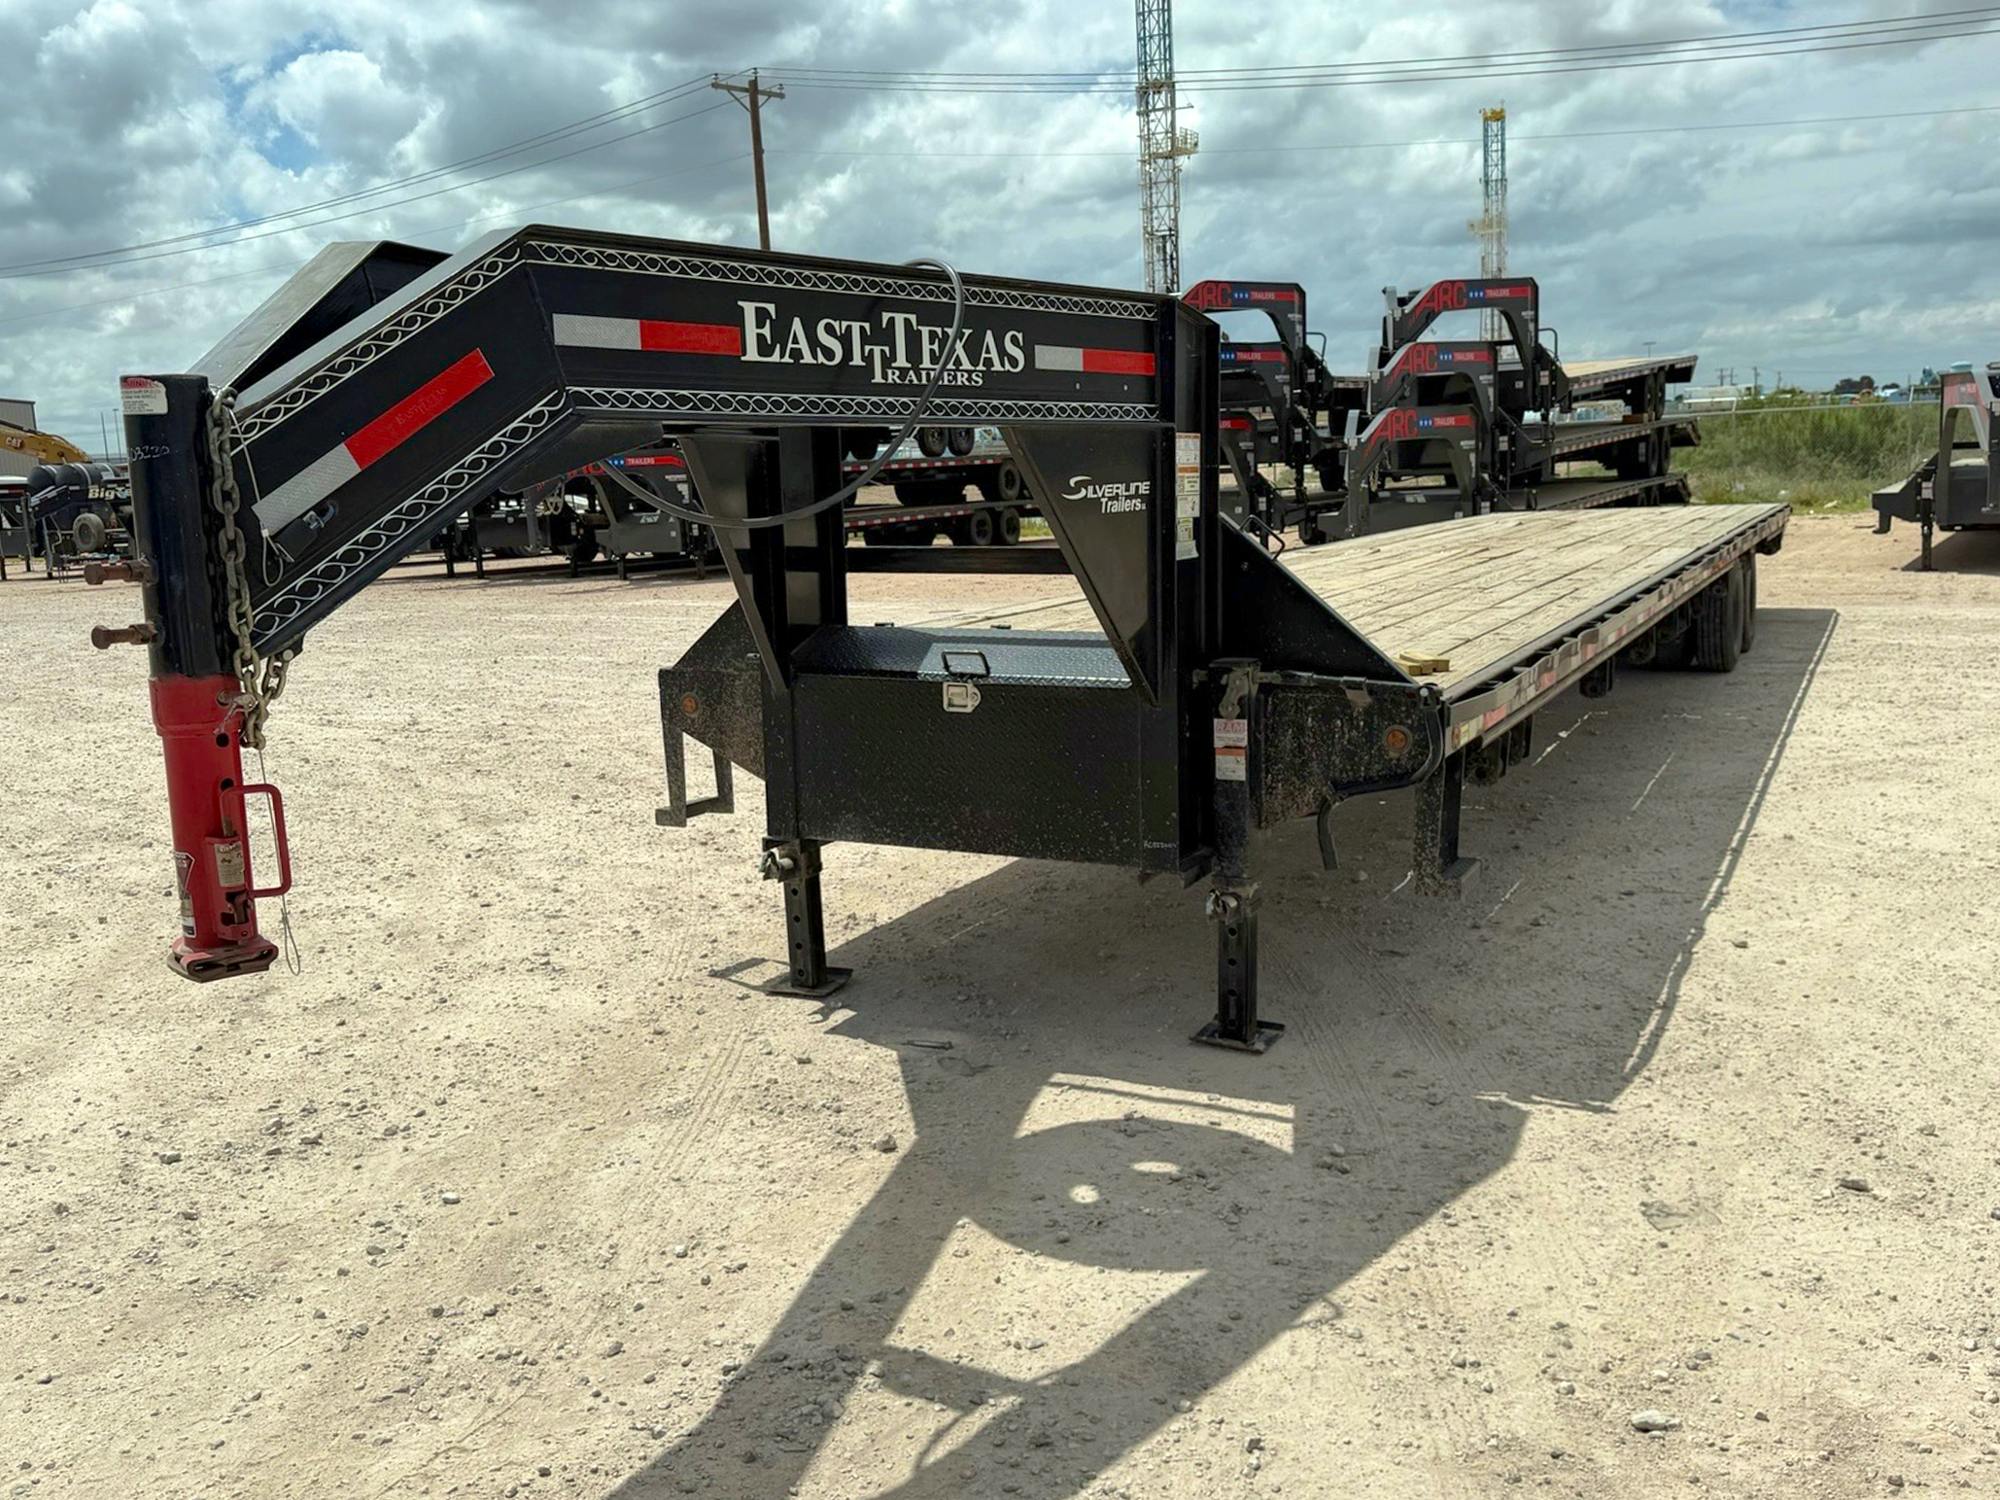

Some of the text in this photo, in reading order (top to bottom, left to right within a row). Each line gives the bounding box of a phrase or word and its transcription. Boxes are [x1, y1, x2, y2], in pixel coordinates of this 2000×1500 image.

[1412, 281, 1467, 319] ARC
[738, 301, 1026, 373] EAST TEXAS
[1390, 344, 1438, 382] ARC
[1371, 408, 1418, 446] ARC
[627, 457, 655, 466] TRAILERS
[1061, 475, 1151, 500] SILVERLINE
[1101, 497, 1142, 514] Trailers
